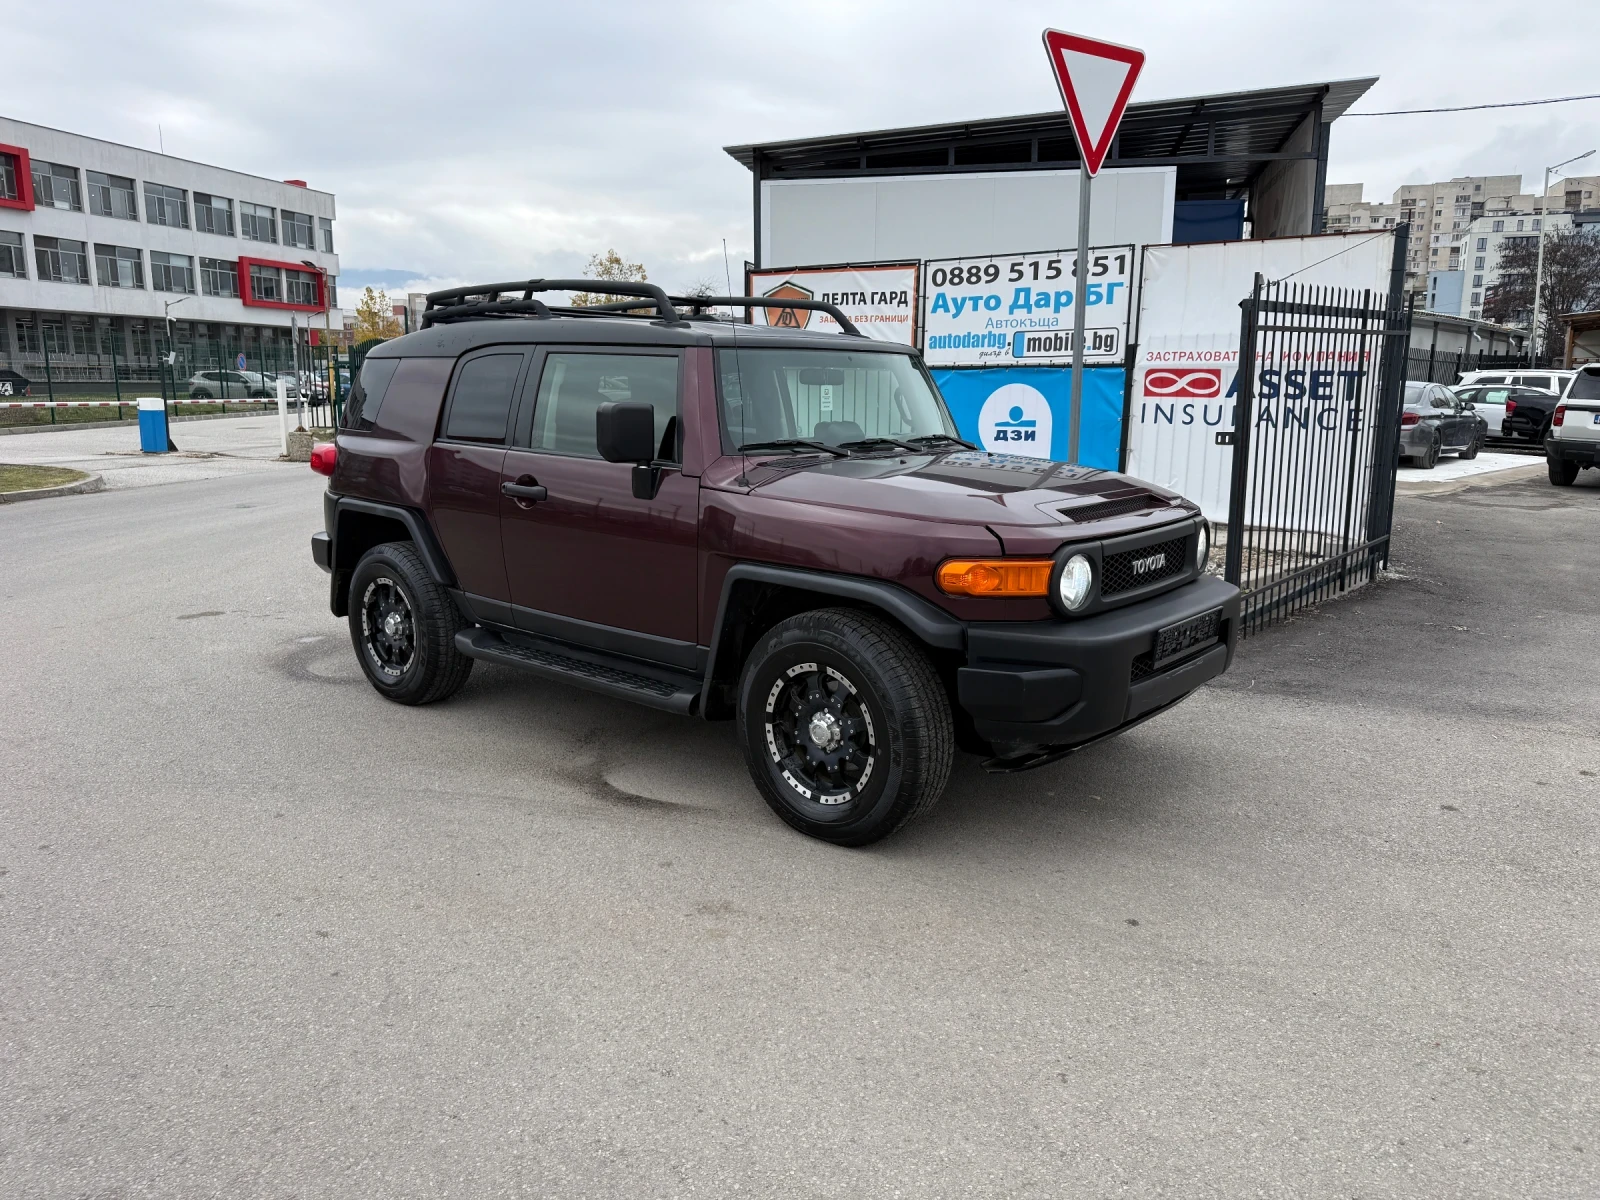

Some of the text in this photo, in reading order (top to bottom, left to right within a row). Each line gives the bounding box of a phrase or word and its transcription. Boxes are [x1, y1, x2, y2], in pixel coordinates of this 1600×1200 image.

[931, 264, 1000, 287] 0889
[1008, 259, 1062, 283] 515
[822, 291, 909, 307] ДЕЛТА ГАРД
[930, 282, 1124, 319] Ауто Дар БГ
[854, 315, 869, 323] БЕЗ
[869, 314, 909, 325] ГРАНИЦИ
[985, 316, 1059, 329] Автокъща
[1140, 403, 1363, 432] INSUANCE
[993, 430, 1036, 442] ДЗИ
[1132, 553, 1166, 575] TOYOTA
